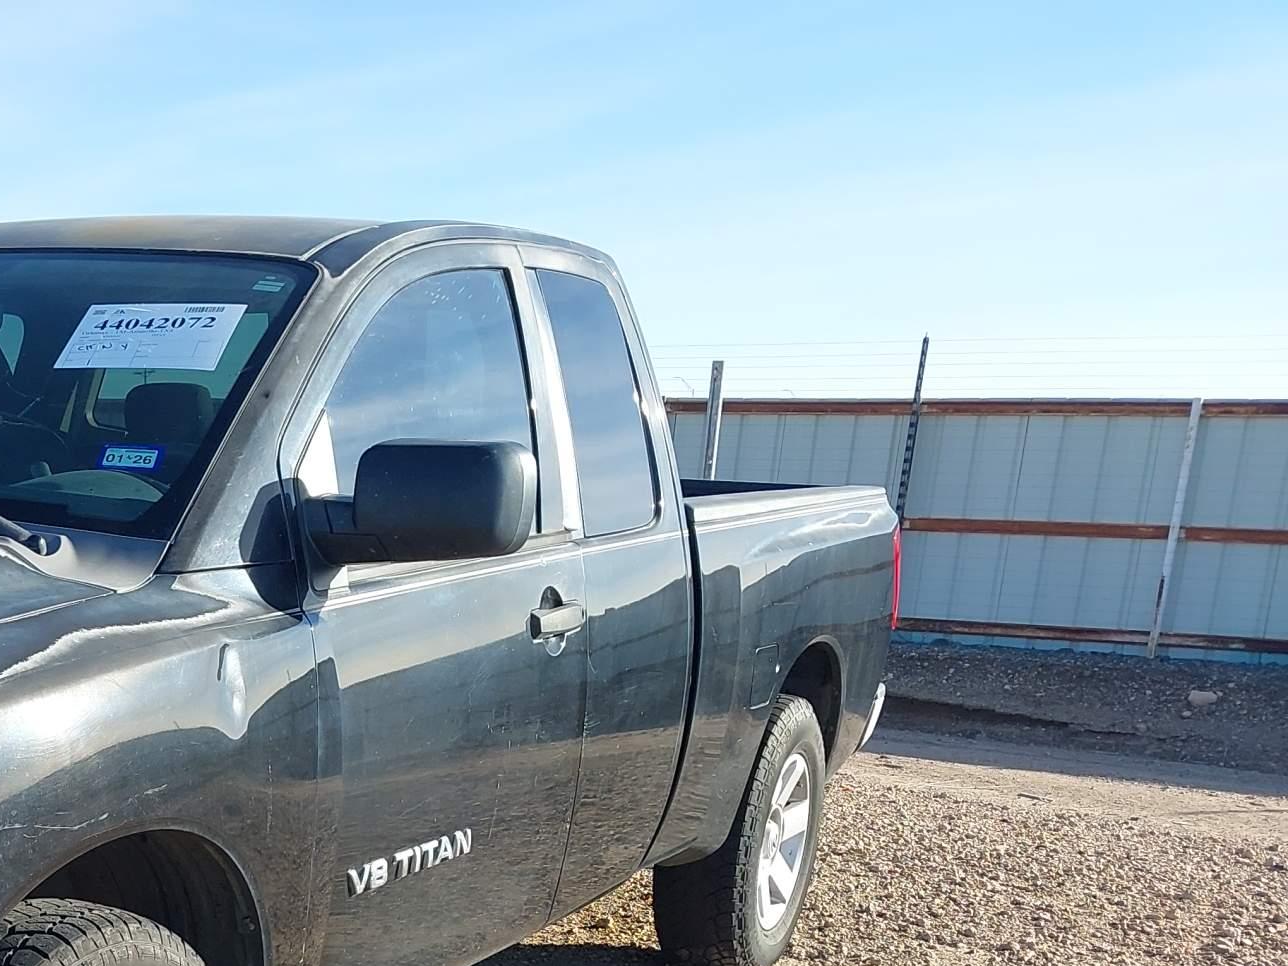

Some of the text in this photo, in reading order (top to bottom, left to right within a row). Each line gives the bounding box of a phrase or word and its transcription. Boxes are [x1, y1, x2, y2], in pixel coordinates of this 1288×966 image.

[94, 316, 217, 331] 44042072
[105, 453, 153, 464] 01 26
[347, 828, 472, 897] V8 TITAN
